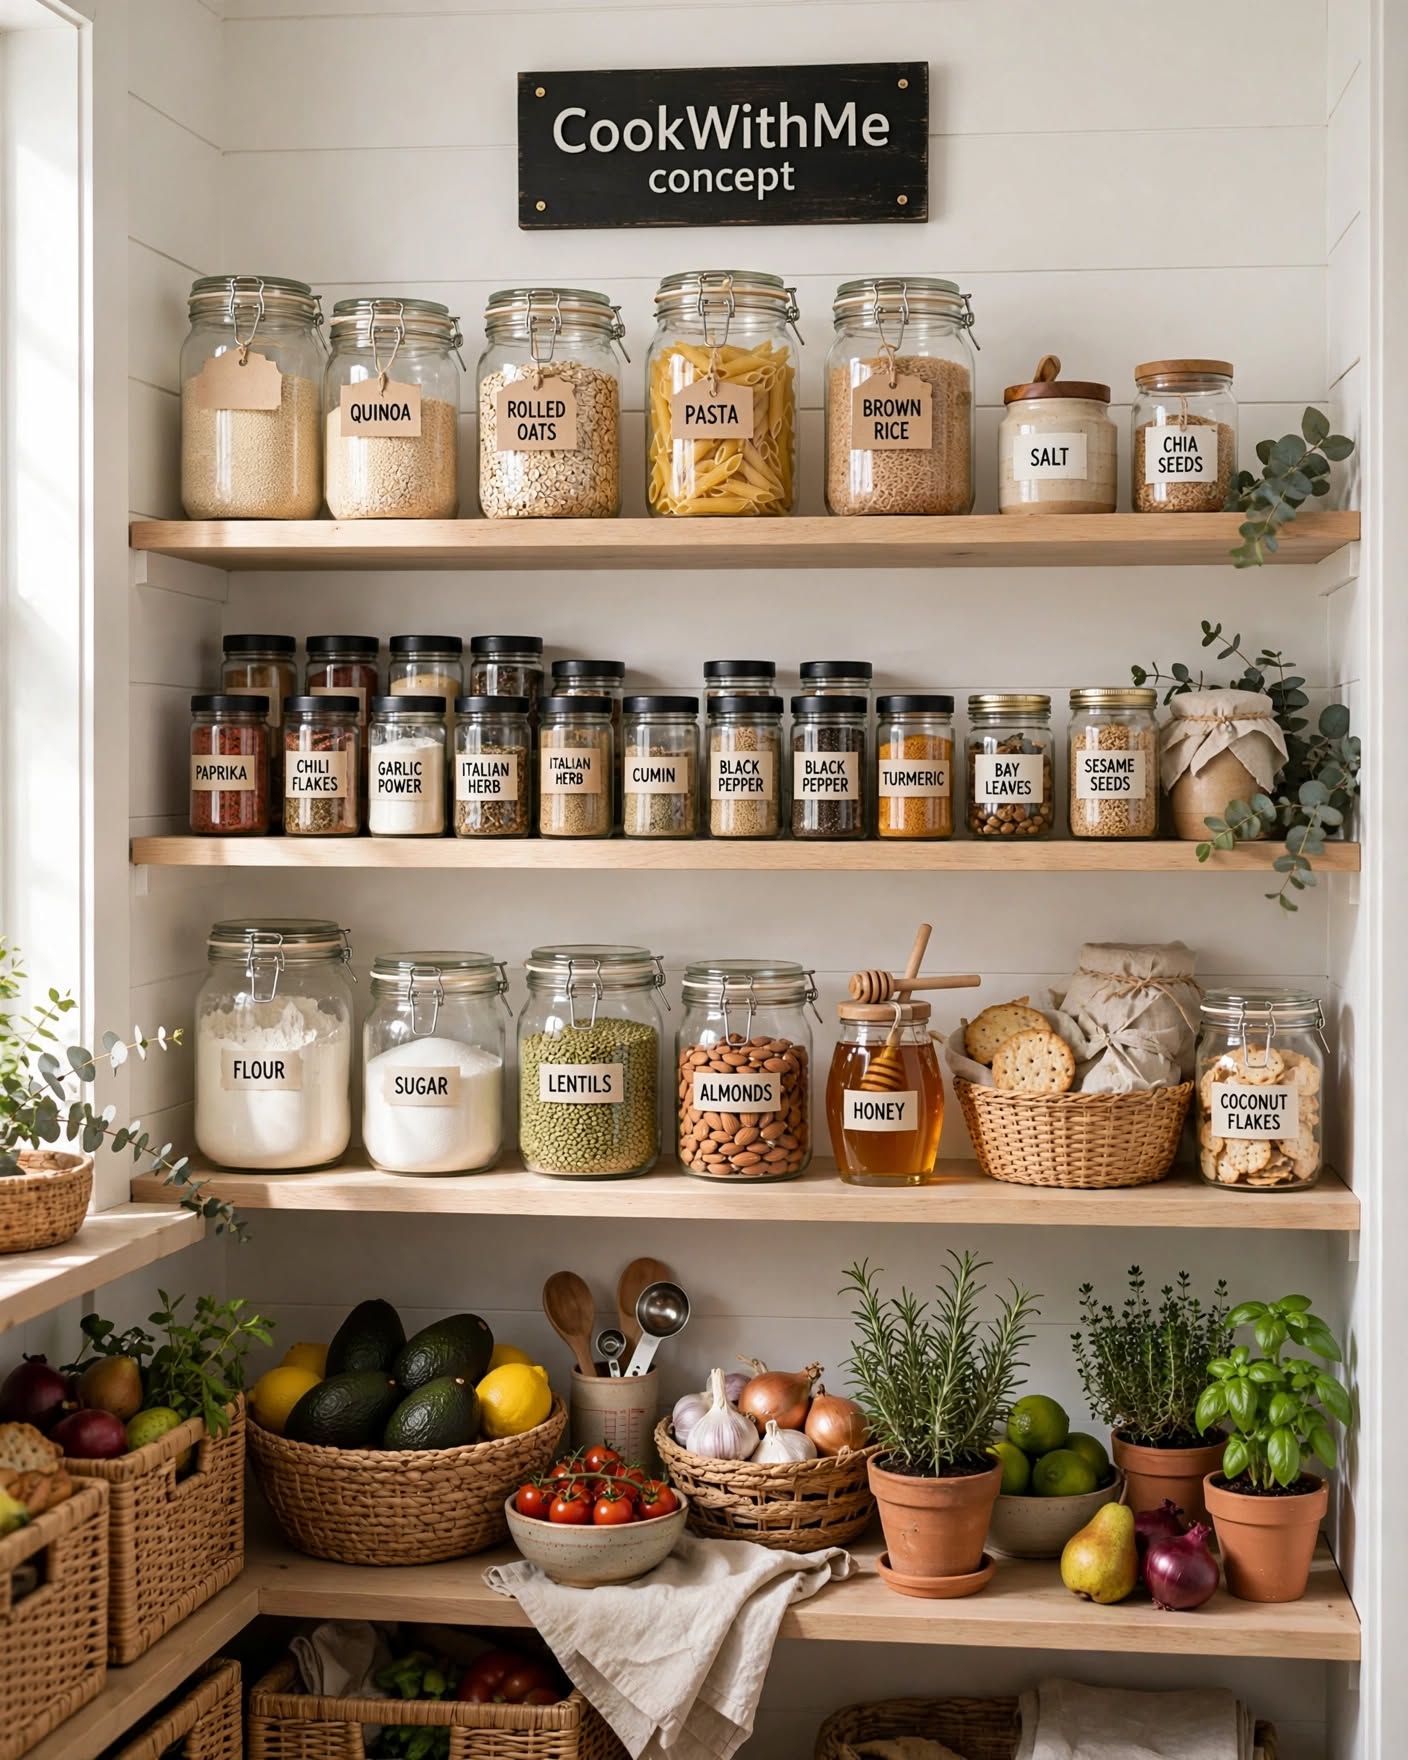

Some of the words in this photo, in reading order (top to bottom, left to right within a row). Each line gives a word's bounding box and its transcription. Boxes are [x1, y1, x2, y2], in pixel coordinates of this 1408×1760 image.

[553, 101, 890, 154] CookWithMe
[648, 161, 795, 201] concept
[350, 403, 411, 424] QUINOA
[507, 400, 566, 419] ROLLED
[685, 404, 739, 425] PASTA
[863, 398, 921, 418] BROWN
[517, 422, 557, 441] OATS
[874, 421, 910, 440] RICE
[1163, 435, 1199, 453] CHIA
[1030, 447, 1070, 467] SALT
[1158, 455, 1204, 474] SEEDS
[296, 759, 329, 774] CHILI
[377, 761, 423, 776] GARLIC
[462, 761, 510, 777] ITALIAN
[549, 756, 591, 771] ITALIAN
[719, 759, 760, 775] BLACK
[805, 759, 846, 775] BLACK
[995, 762, 1020, 778] BAY
[1084, 758, 1135, 774] SESAME
[195, 764, 248, 781] PAPRIKA
[555, 771, 584, 785] HERB
[632, 767, 676, 783] CUMIN
[882, 770, 945, 787] TURMERIC
[292, 776, 339, 792] FLAKES
[378, 778, 423, 794] POWER
[468, 778, 501, 794] HERB
[718, 777, 765, 793] PEPPER
[802, 777, 849, 793] PEPPER
[985, 780, 1032, 796] LEAVES
[1090, 775, 1131, 792] SEEDS
[233, 1060, 285, 1080] FLOUR
[395, 1076, 449, 1096] SUGAR
[549, 1073, 612, 1094] LENTILS
[700, 1083, 773, 1103] ALMONDS
[1220, 1093, 1288, 1111] COCONUT
[854, 1101, 906, 1121] HONEY
[1228, 1113, 1281, 1131] FLAKES
